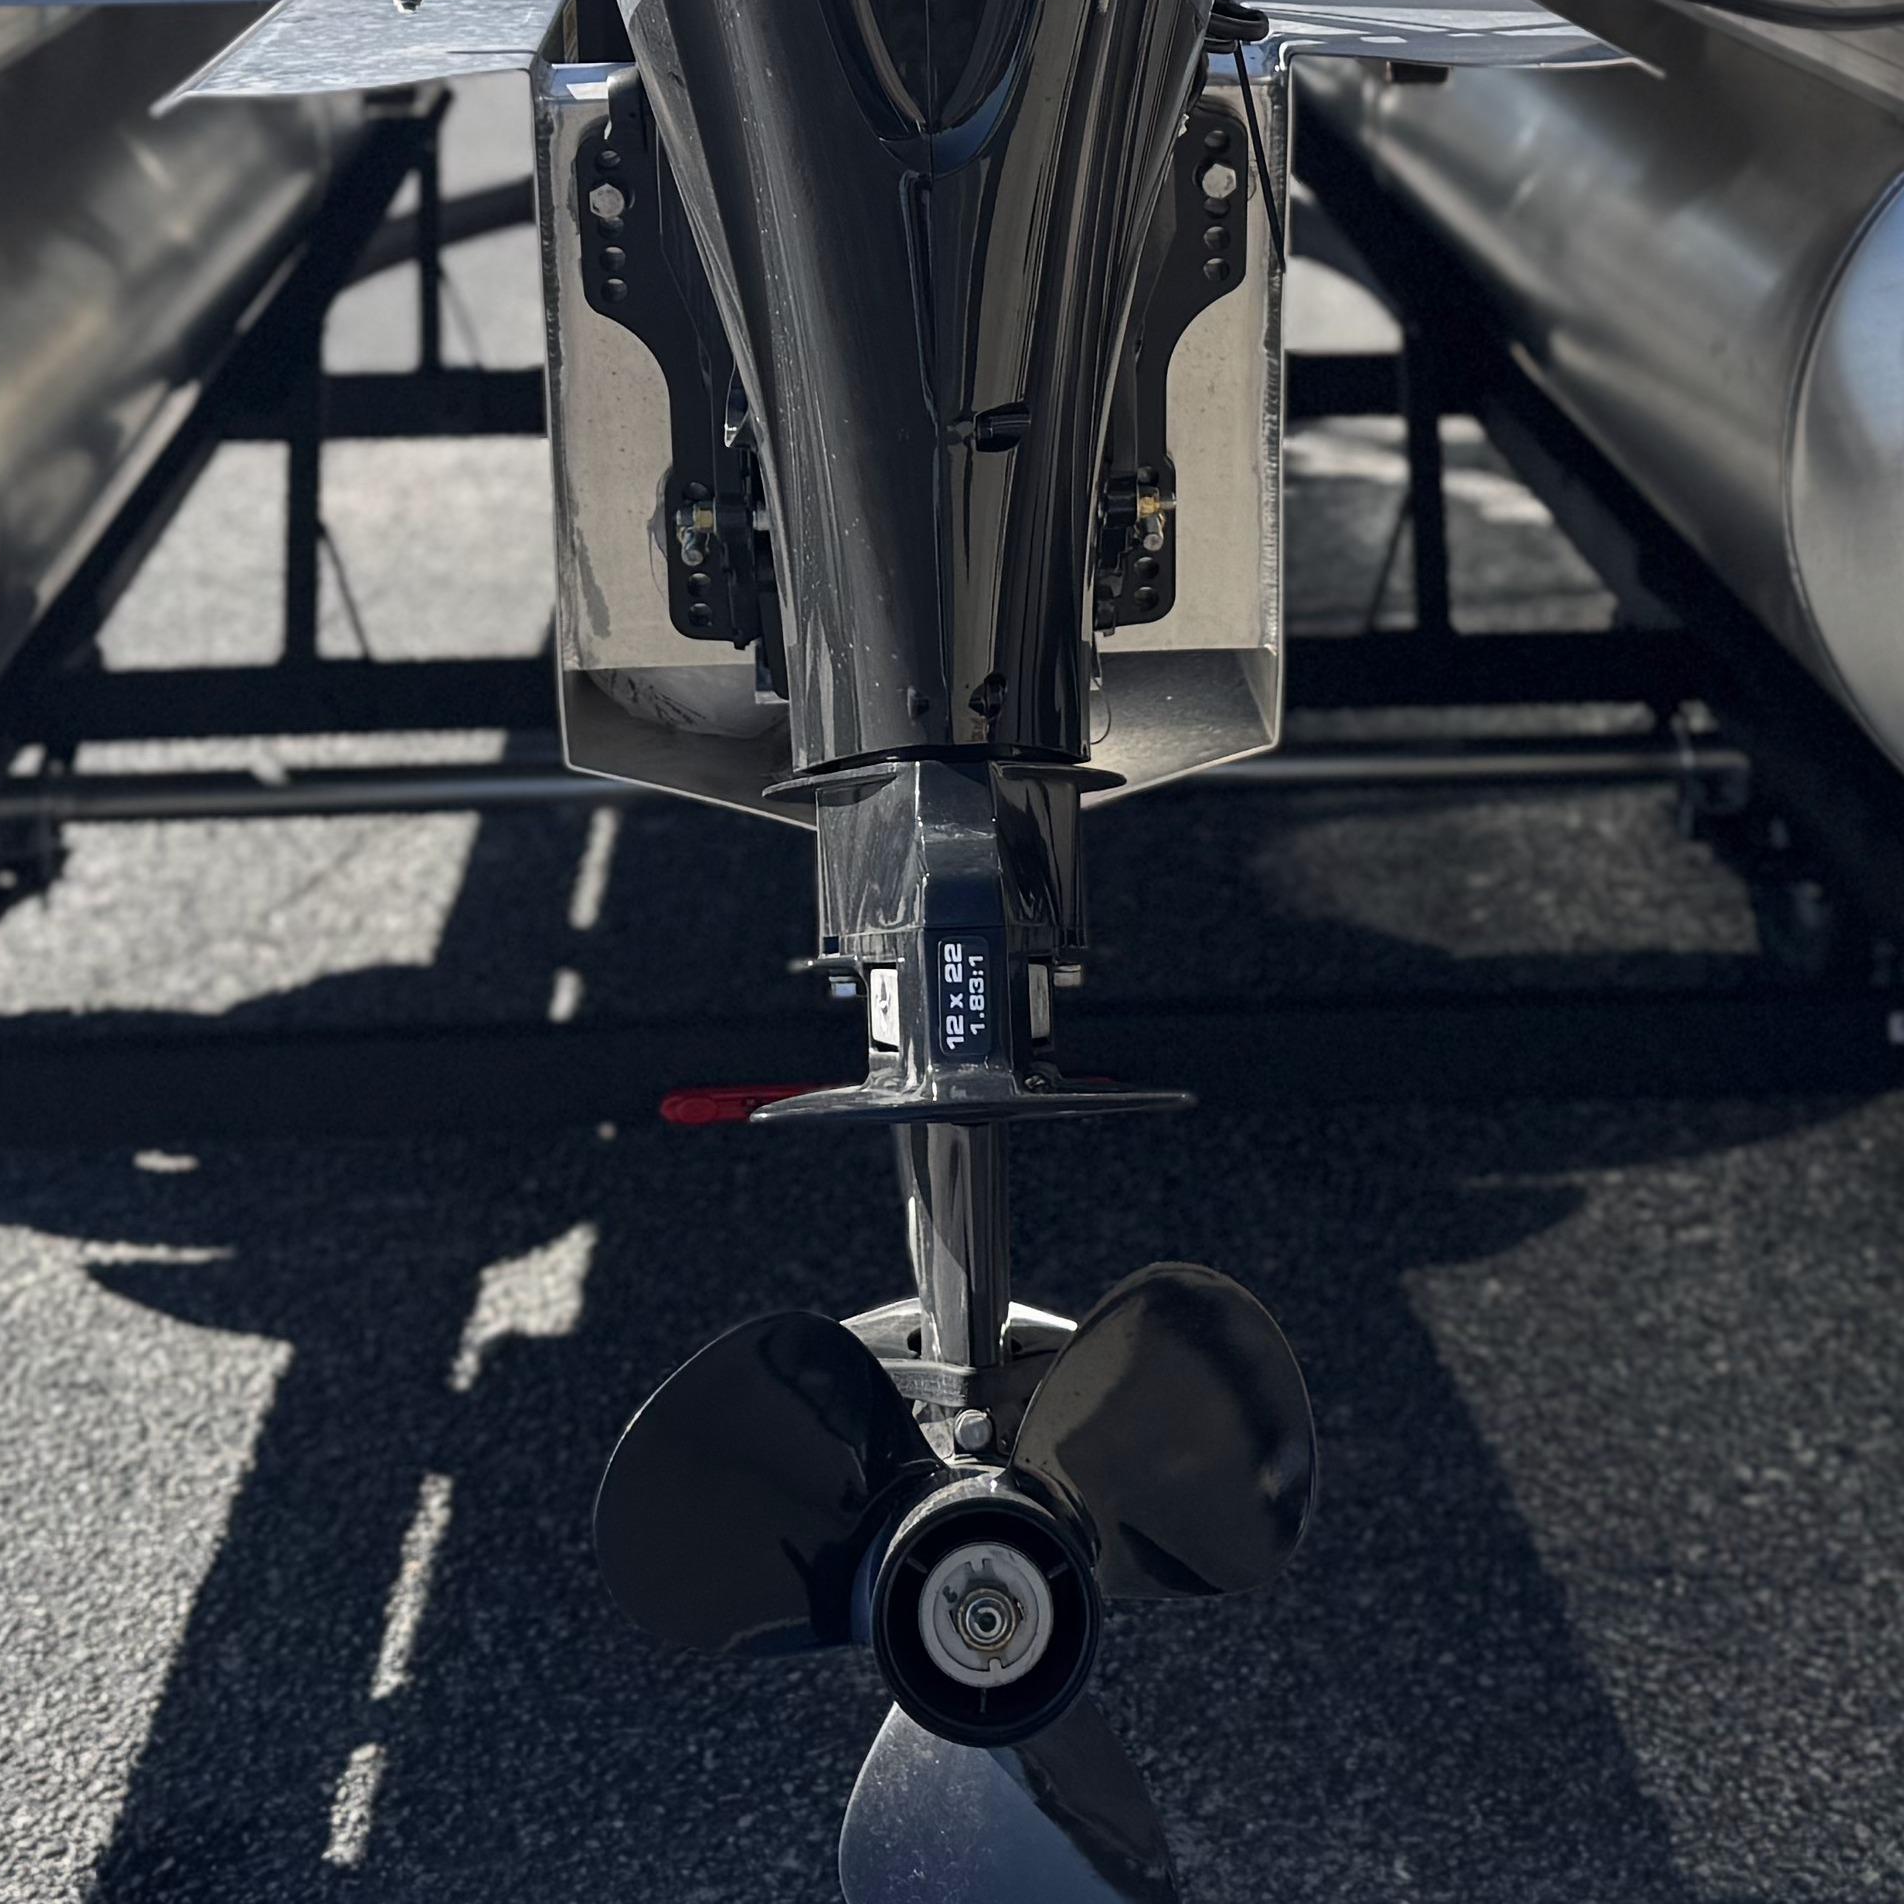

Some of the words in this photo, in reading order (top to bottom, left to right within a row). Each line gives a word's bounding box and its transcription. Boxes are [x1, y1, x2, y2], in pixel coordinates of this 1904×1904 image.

[945, 943, 963, 984] 22
[969, 955, 986, 1036] 1.83:1
[946, 1013, 965, 1050] 12
